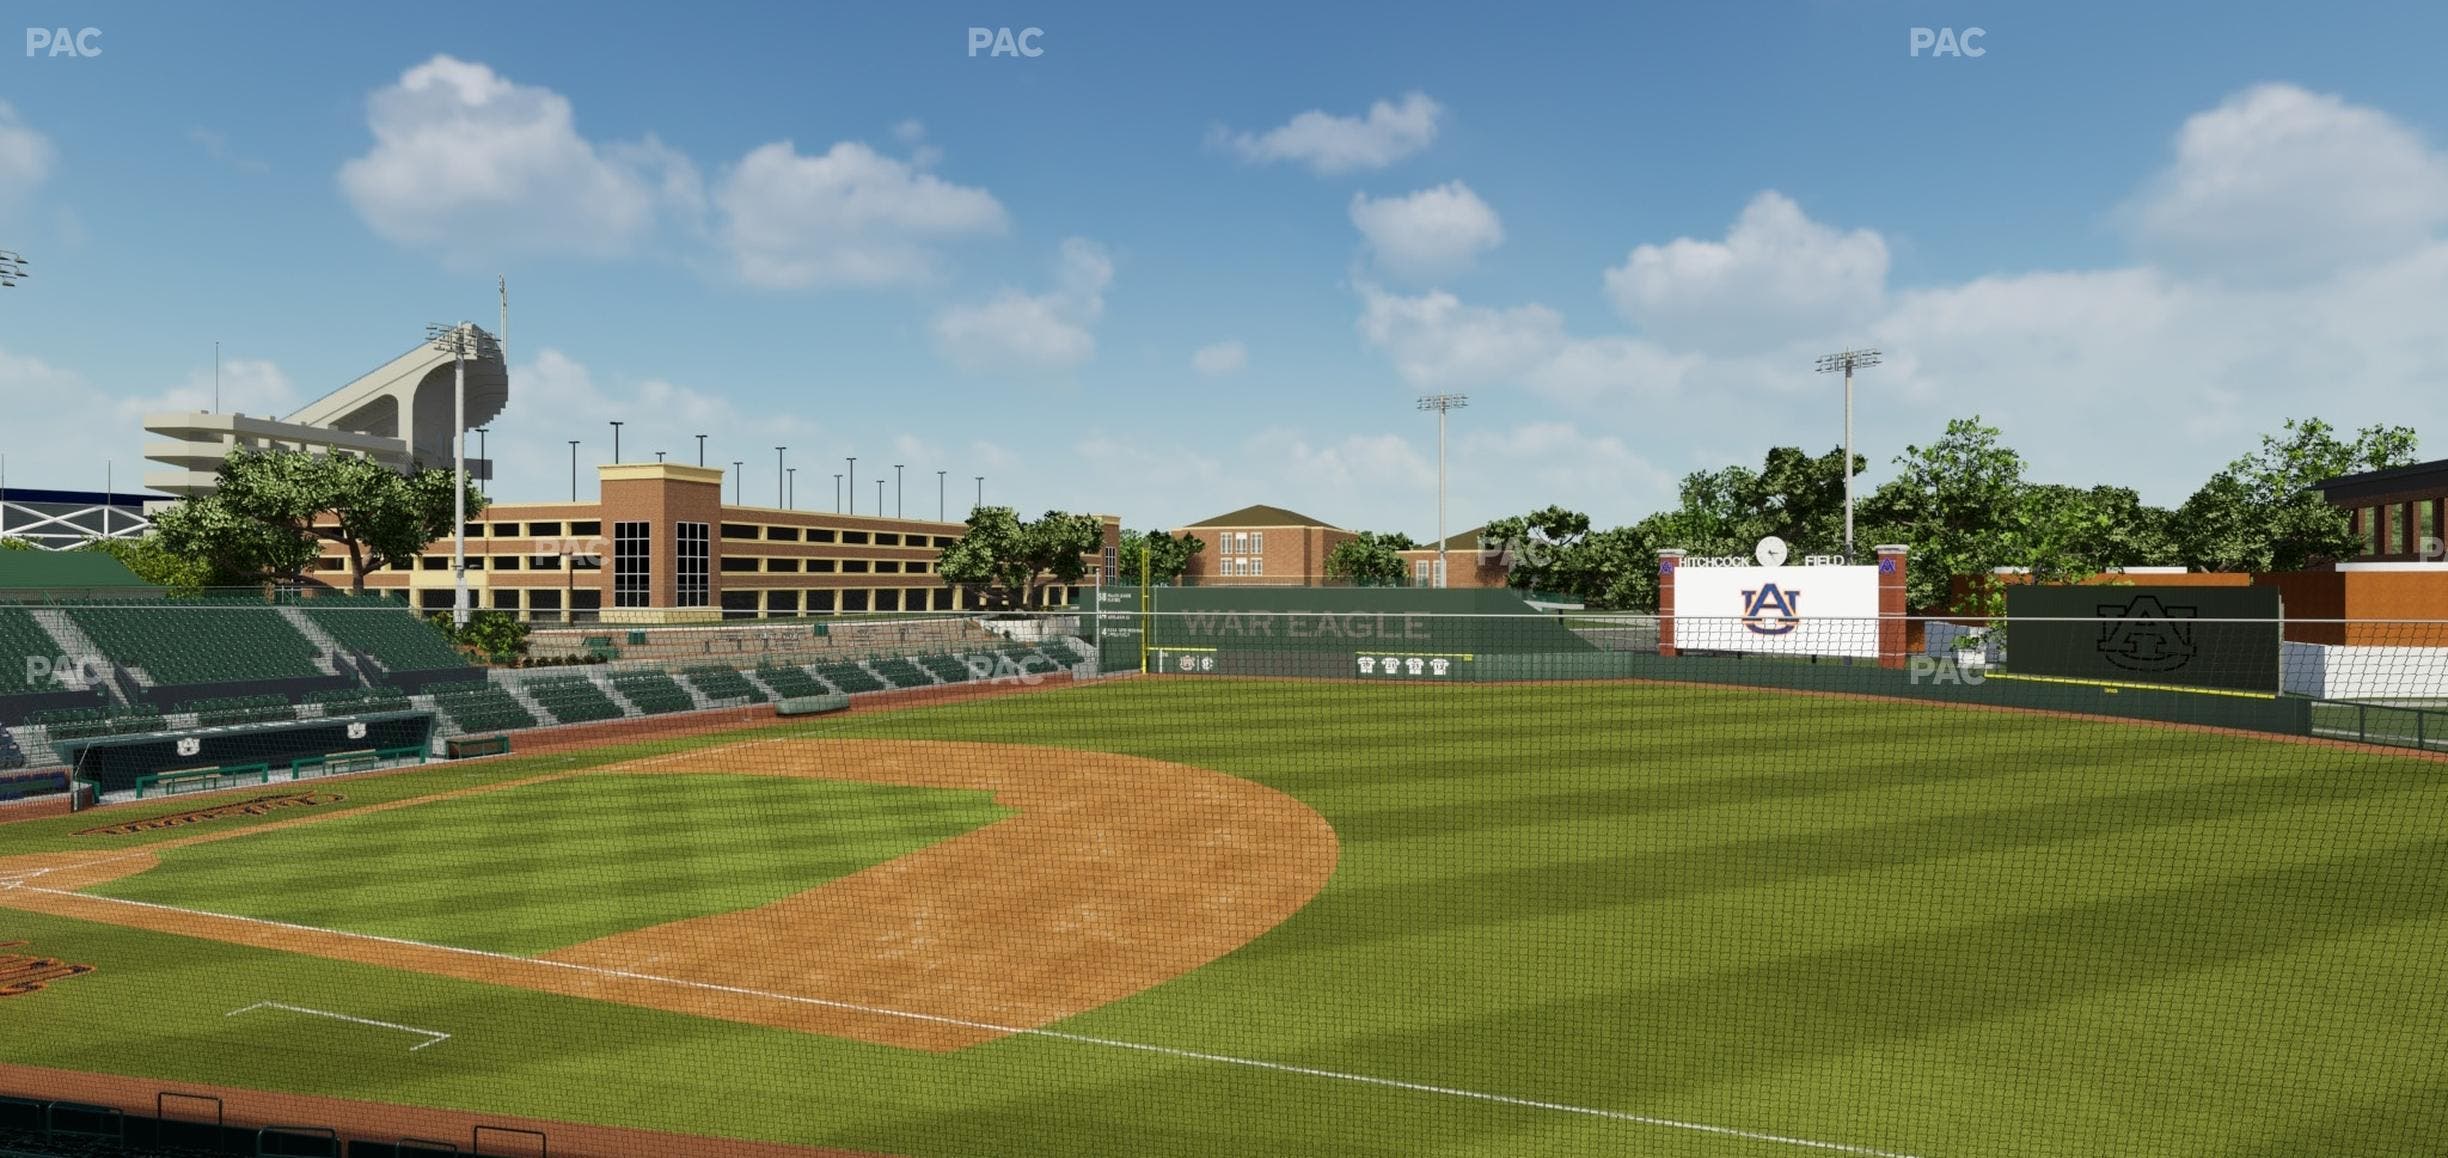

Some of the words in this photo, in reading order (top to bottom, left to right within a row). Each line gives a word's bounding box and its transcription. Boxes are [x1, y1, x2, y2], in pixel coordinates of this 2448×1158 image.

[1679, 556, 1750, 568] HITCHCOCK
[1804, 554, 1845, 567] FIELD
[1181, 608, 1275, 637] WAR
[1286, 609, 1432, 639] EAGLE
